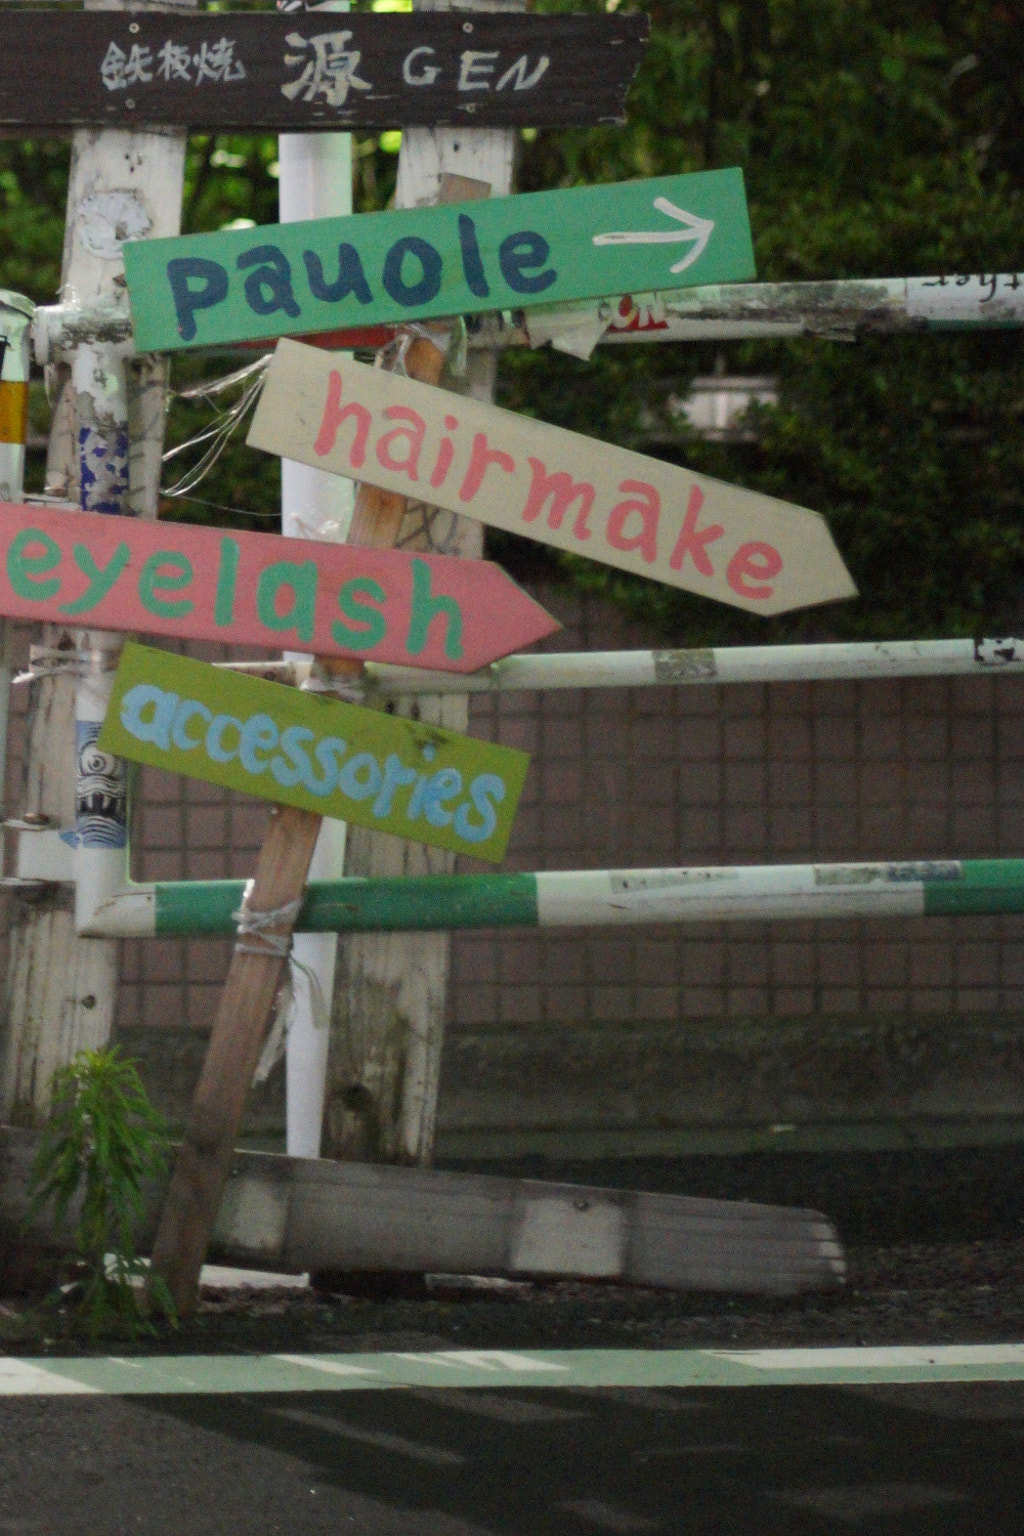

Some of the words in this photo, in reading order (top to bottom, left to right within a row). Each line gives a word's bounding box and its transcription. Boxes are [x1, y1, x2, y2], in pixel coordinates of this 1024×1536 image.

[100, 36, 247, 91] 鉄板焼
[280, 29, 373, 107] 源
[402, 45, 551, 92] GEN
[165, 213, 558, 342] pauole
[312, 369, 784, 601] hairmake
[6, 527, 465, 661] eyelash
[120, 683, 506, 844] accessories
